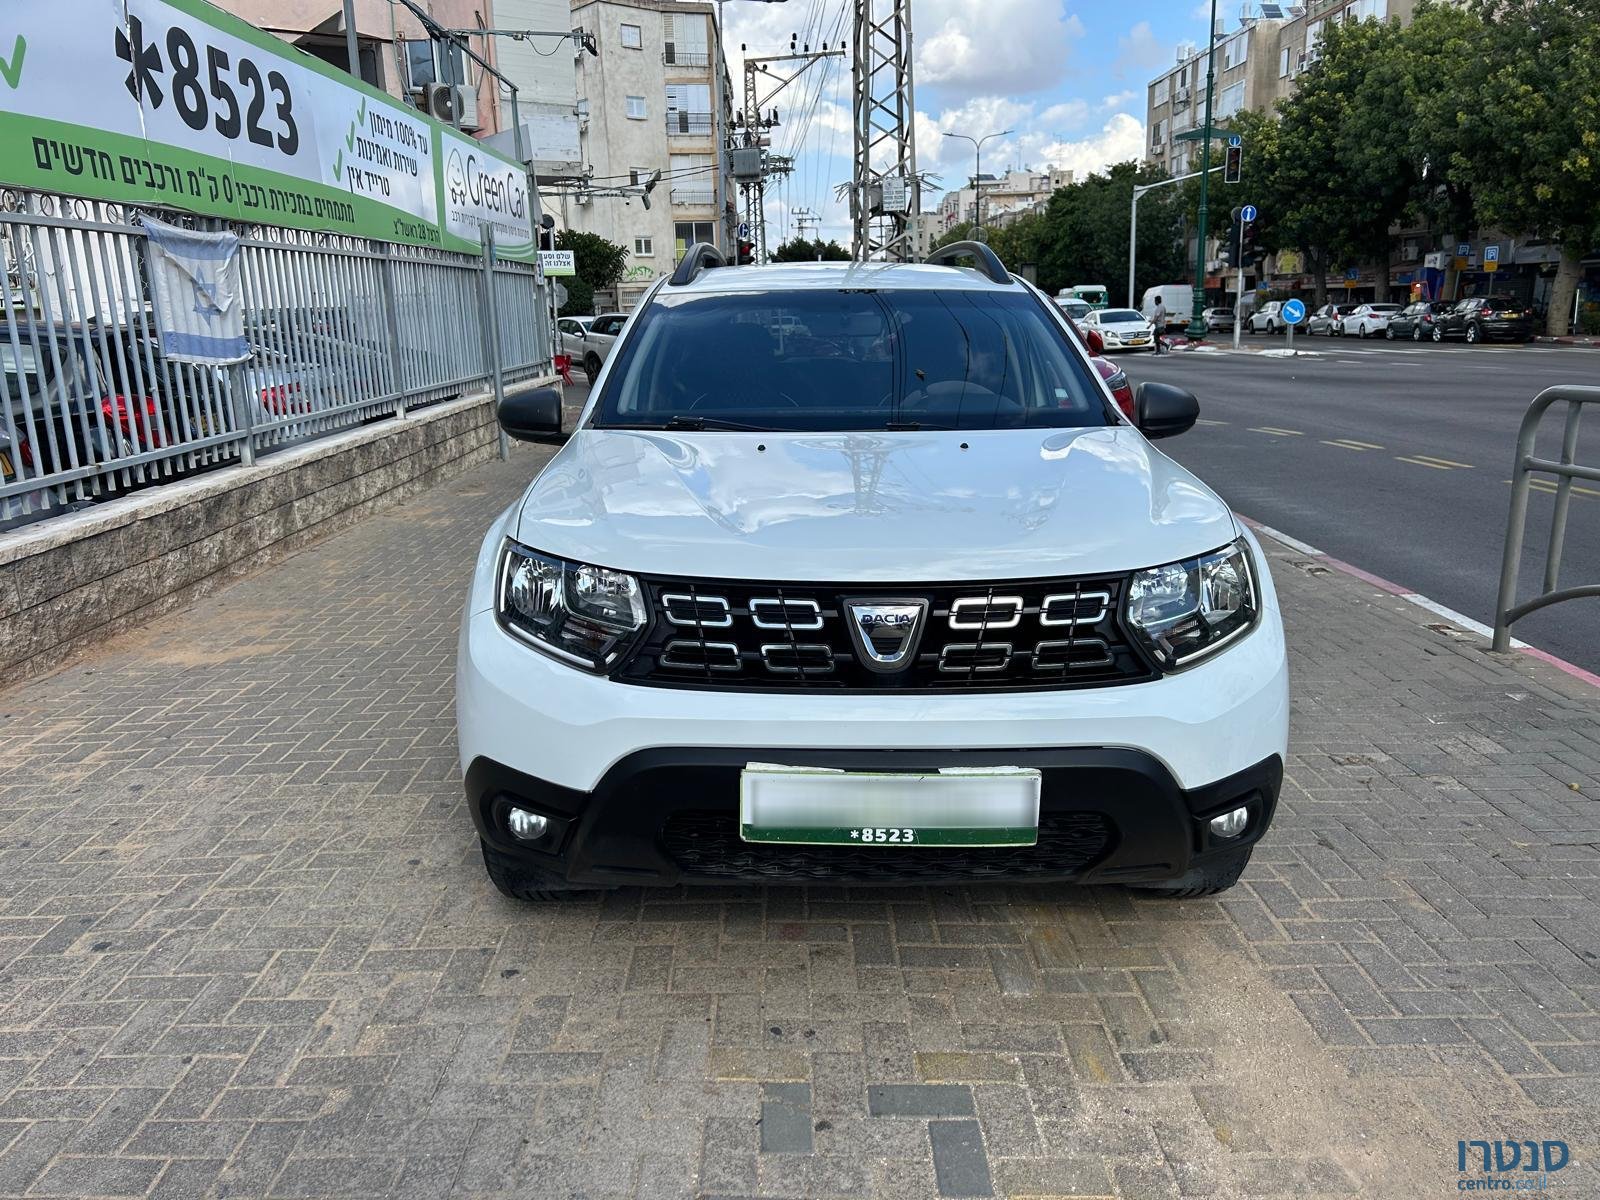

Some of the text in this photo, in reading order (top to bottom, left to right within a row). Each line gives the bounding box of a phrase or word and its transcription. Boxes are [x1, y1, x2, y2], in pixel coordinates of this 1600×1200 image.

[369, 111, 428, 155] עד 100% מימון
[32, 136, 116, 182] חדשים
[357, 136, 418, 177] שירות ואמינות
[119, 155, 183, 194] ורכבים
[222, 174, 233, 203] 0
[347, 165, 390, 196] טרייד אין
[467, 154, 526, 219] Green Car
[235, 182, 268, 209] רכבי
[269, 188, 313, 216] במכירת
[314, 197, 355, 223] מתמחים
[418, 223, 426, 240] 28
[556, 252, 571, 260] שלם
[861, 614, 911, 623] DACIA
